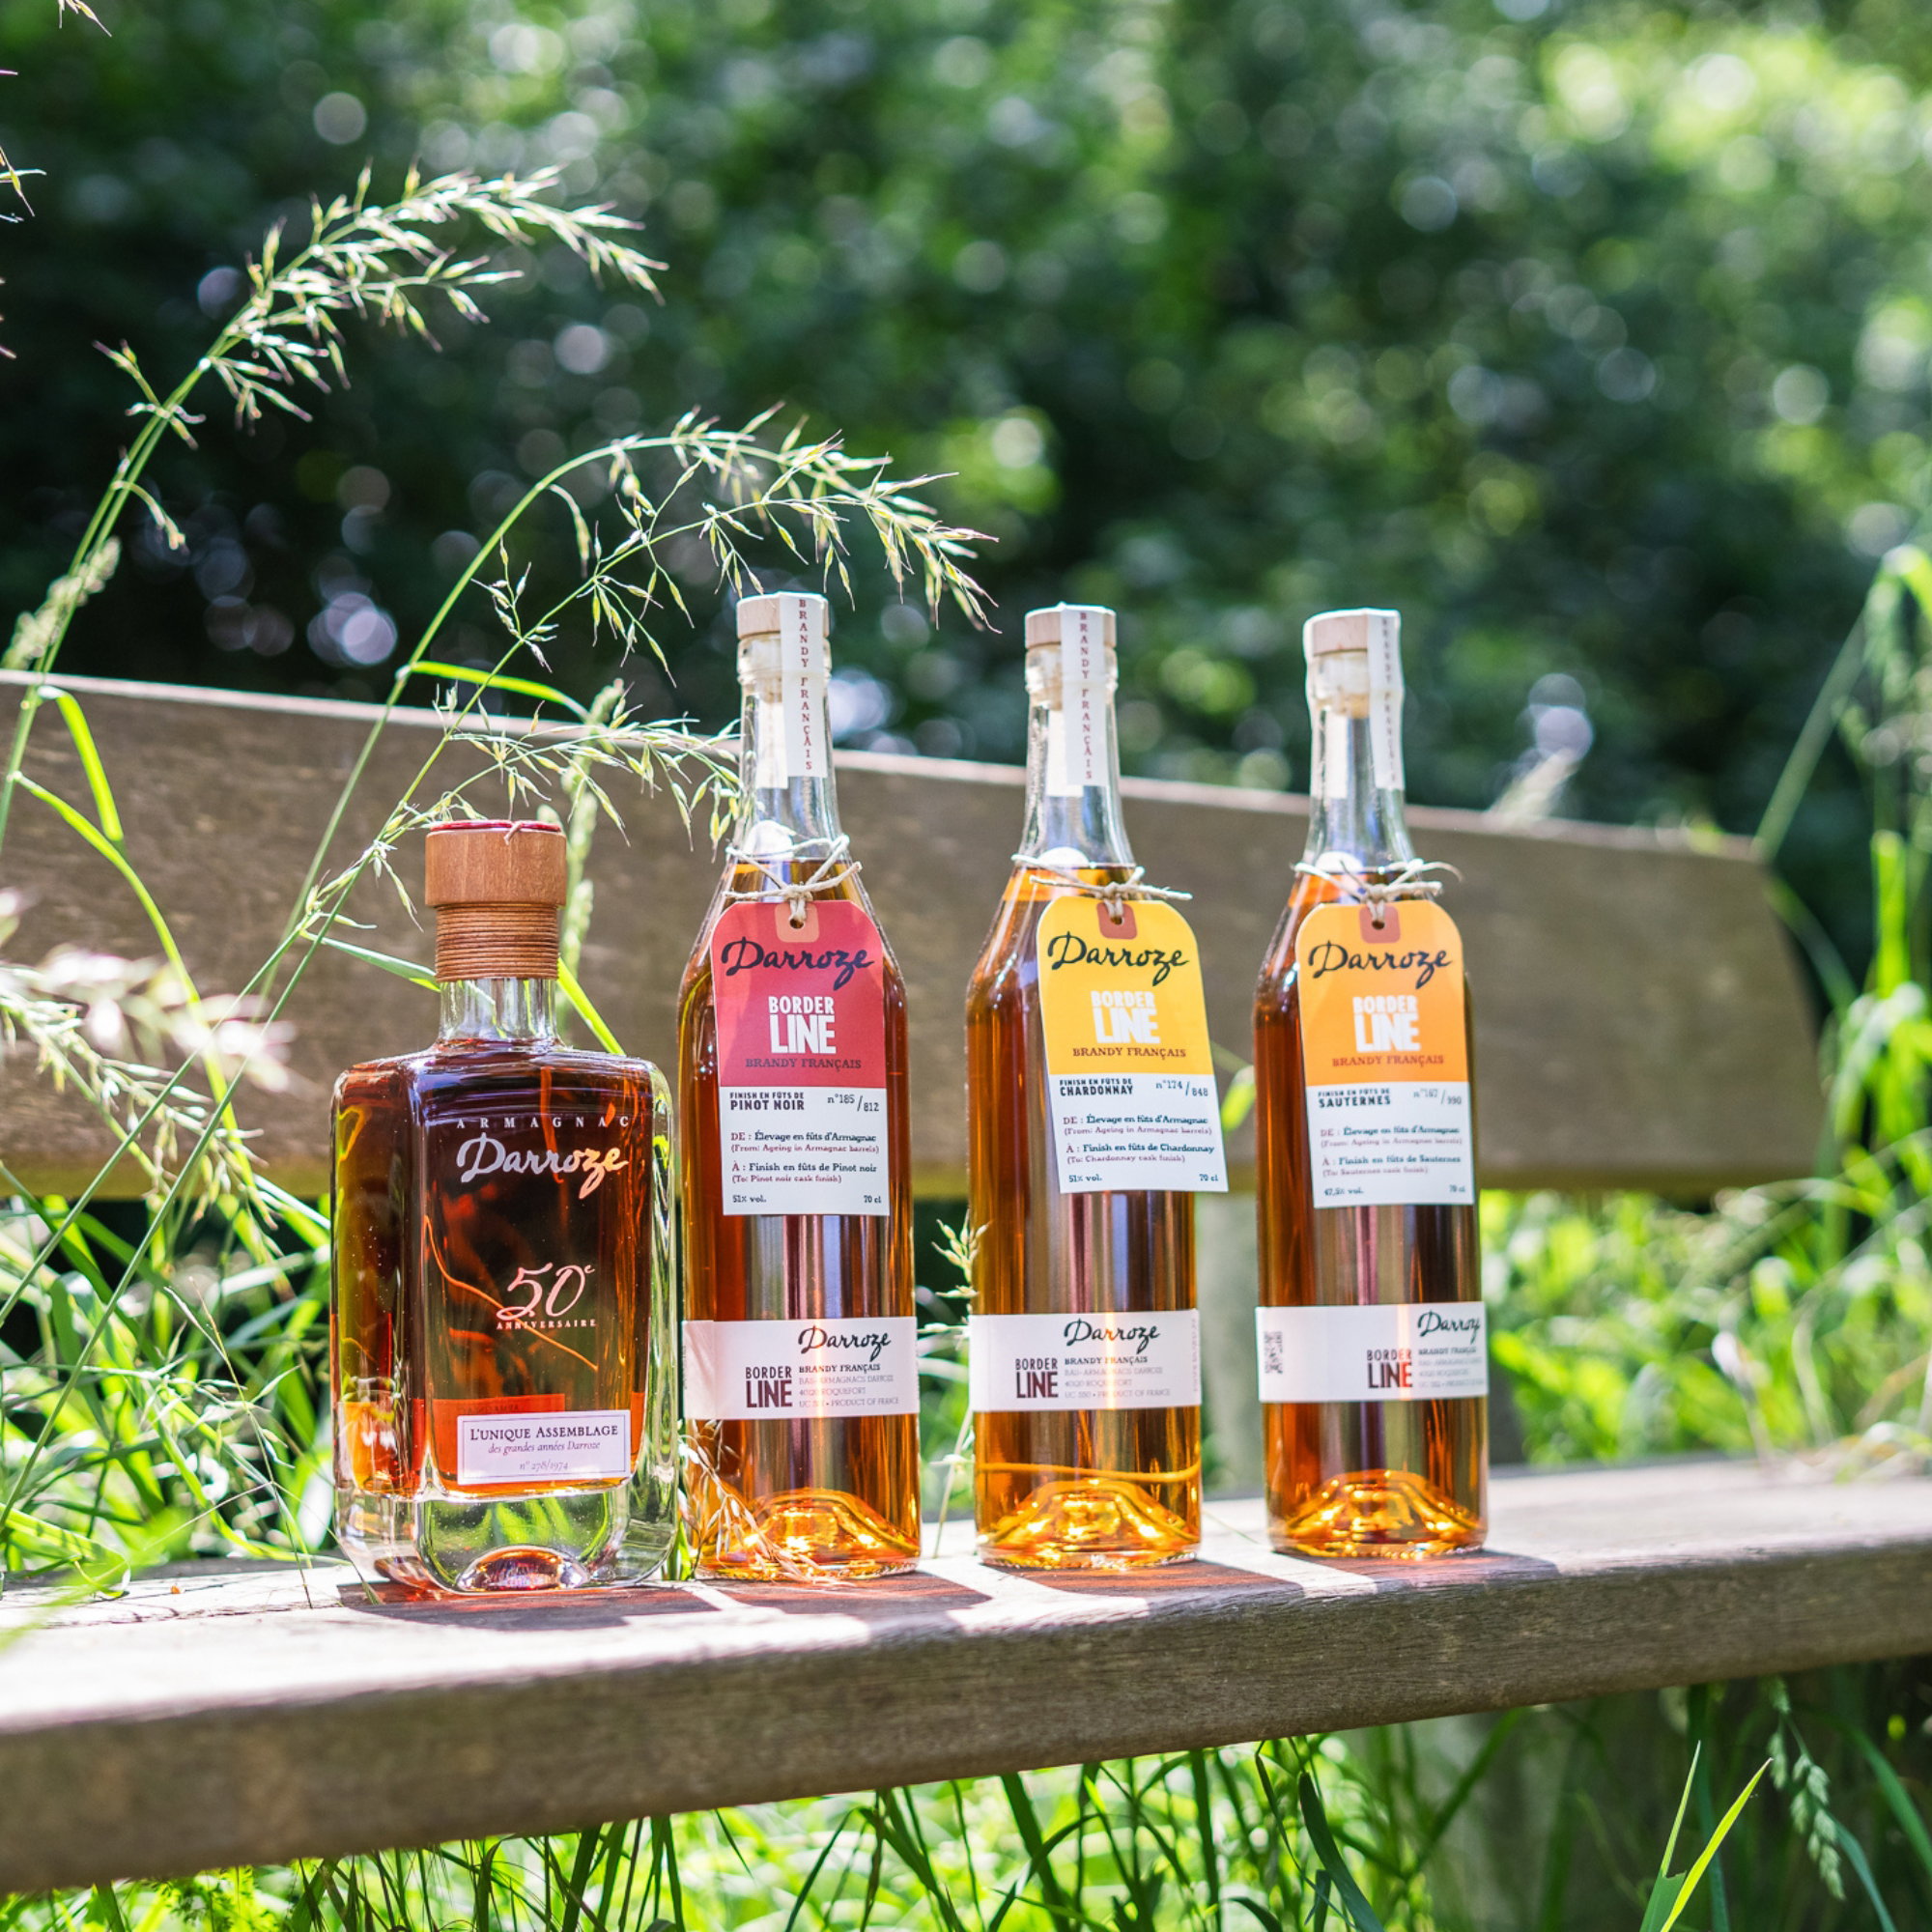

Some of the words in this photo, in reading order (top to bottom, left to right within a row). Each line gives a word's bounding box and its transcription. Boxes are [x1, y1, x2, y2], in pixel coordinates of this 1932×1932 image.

[799, 599, 809, 668] BRANDY
[1080, 612, 1090, 679] BRANDY
[800, 677, 812, 770] FRANÇAIS
[721, 936, 875, 991] Darroze
[1047, 931, 1189, 987] Darroze
[1308, 940, 1453, 990] Darroze
[768, 995, 835, 1014] BORDER
[1091, 990, 1155, 1009] BORDER
[1352, 995, 1417, 1013] BORDER
[770, 1014, 837, 1054] LINE
[1093, 1008, 1161, 1044] LINE
[1353, 1013, 1421, 1053] LINE
[1072, 1047, 1122, 1058] BRANDY
[1126, 1047, 1186, 1061] FRANÇAIS
[1332, 1057, 1382, 1067] BRANDY
[1386, 1055, 1444, 1068] FRANÇAIS
[746, 1058, 797, 1068] BRANDY
[801, 1059, 862, 1072] FRANÇAIS
[1060, 1085, 1133, 1096] CHARDONNAY
[730, 1099, 769, 1111] PINOT
[774, 1100, 805, 1110] NOIR
[1319, 1095, 1391, 1108] SAUTERNES
[456, 1117, 629, 1128] ARMAGNAC
[1086, 1113, 1122, 1124] Élevage
[731, 1132, 746, 1141] DE
[754, 1129, 790, 1142] Élevage
[806, 1132, 822, 1141] fûts
[1137, 1126, 1179, 1135] Armagnac
[1065, 1143, 1074, 1153] À
[1083, 1144, 1112, 1152] Finish
[1160, 1143, 1214, 1153] Chardonnay
[455, 1132, 629, 1199] Darroze
[732, 1160, 740, 1172] À
[749, 1163, 780, 1172] Finish
[798, 1162, 816, 1172] fûts
[819, 1163, 830, 1172] de
[833, 1163, 856, 1172] Pinot
[1406, 1154, 1416, 1163] de
[497, 1319, 596, 1330] ANNIVERSAIRE
[797, 1324, 892, 1362] Darroze
[1064, 1318, 1160, 1354] Darroze
[1015, 1357, 1058, 1370] BORDER
[1105, 1356, 1148, 1365] FRANÇAIS
[1367, 1350, 1411, 1361] BORDER
[746, 1366, 792, 1379] BORDER
[839, 1363, 881, 1374] FRANÇAIS
[1368, 1362, 1413, 1389] LINE
[1016, 1372, 1059, 1399] LINE
[746, 1380, 793, 1408] LINE
[470, 1428, 531, 1442] L'UNIQUE
[536, 1425, 618, 1438] ASSEMBLAGE
[488, 1443, 501, 1454] des
[502, 1441, 535, 1456] grandes
[537, 1440, 564, 1452] années
[567, 1440, 601, 1451] Darroze
